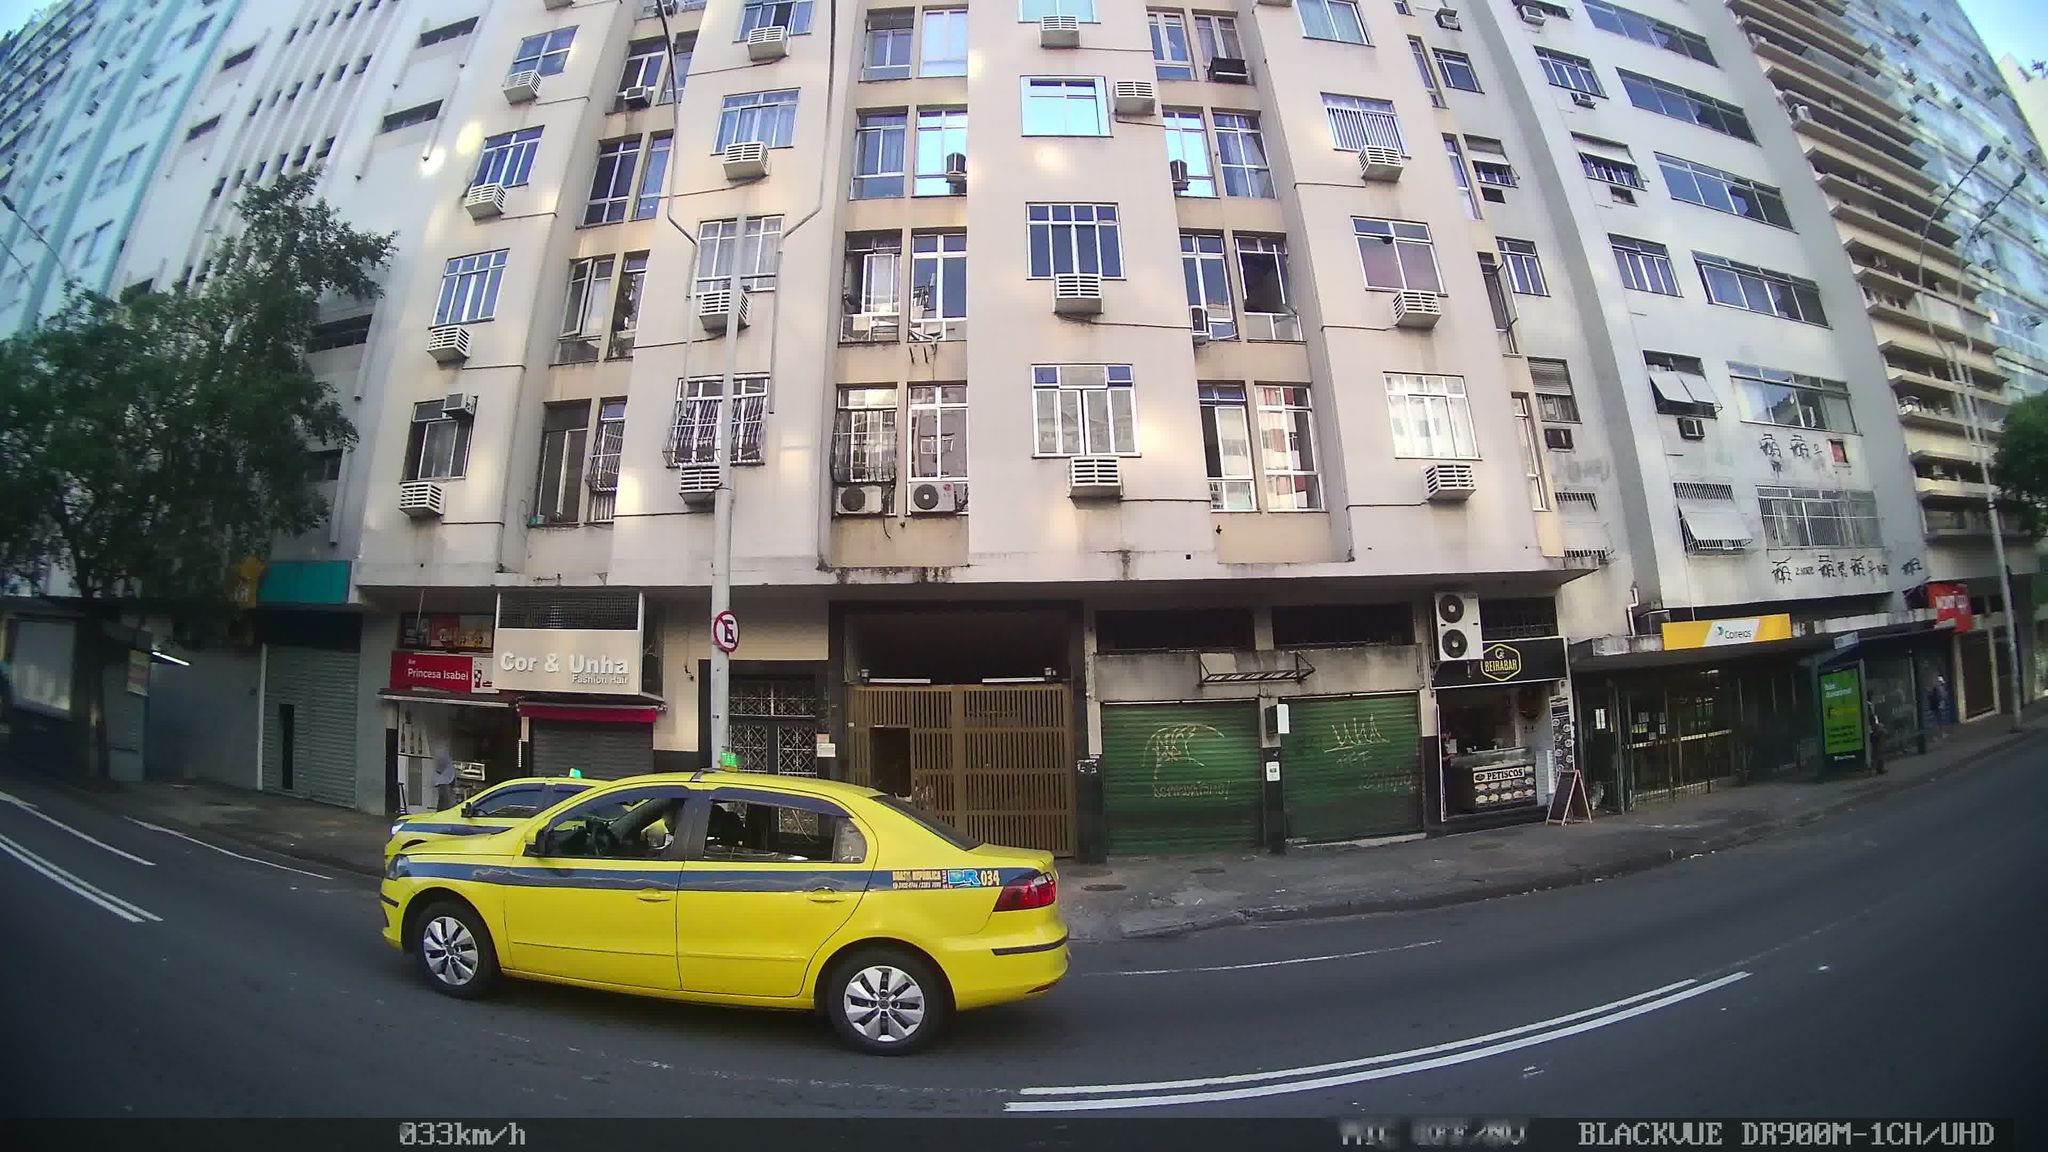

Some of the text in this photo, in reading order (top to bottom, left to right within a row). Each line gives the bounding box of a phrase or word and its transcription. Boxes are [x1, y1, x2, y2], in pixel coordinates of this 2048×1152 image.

[724, 620, 734, 644] E
[1724, 629, 1752, 640] Correios
[500, 652, 630, 675] Cor & Unha
[1484, 659, 1518, 673] BEIRABAR
[407, 668, 469, 681] Princesa Isabel
[572, 674, 607, 685] Fashion
[1487, 768, 1523, 781] PETISCOS
[980, 869, 1000, 886] 034
